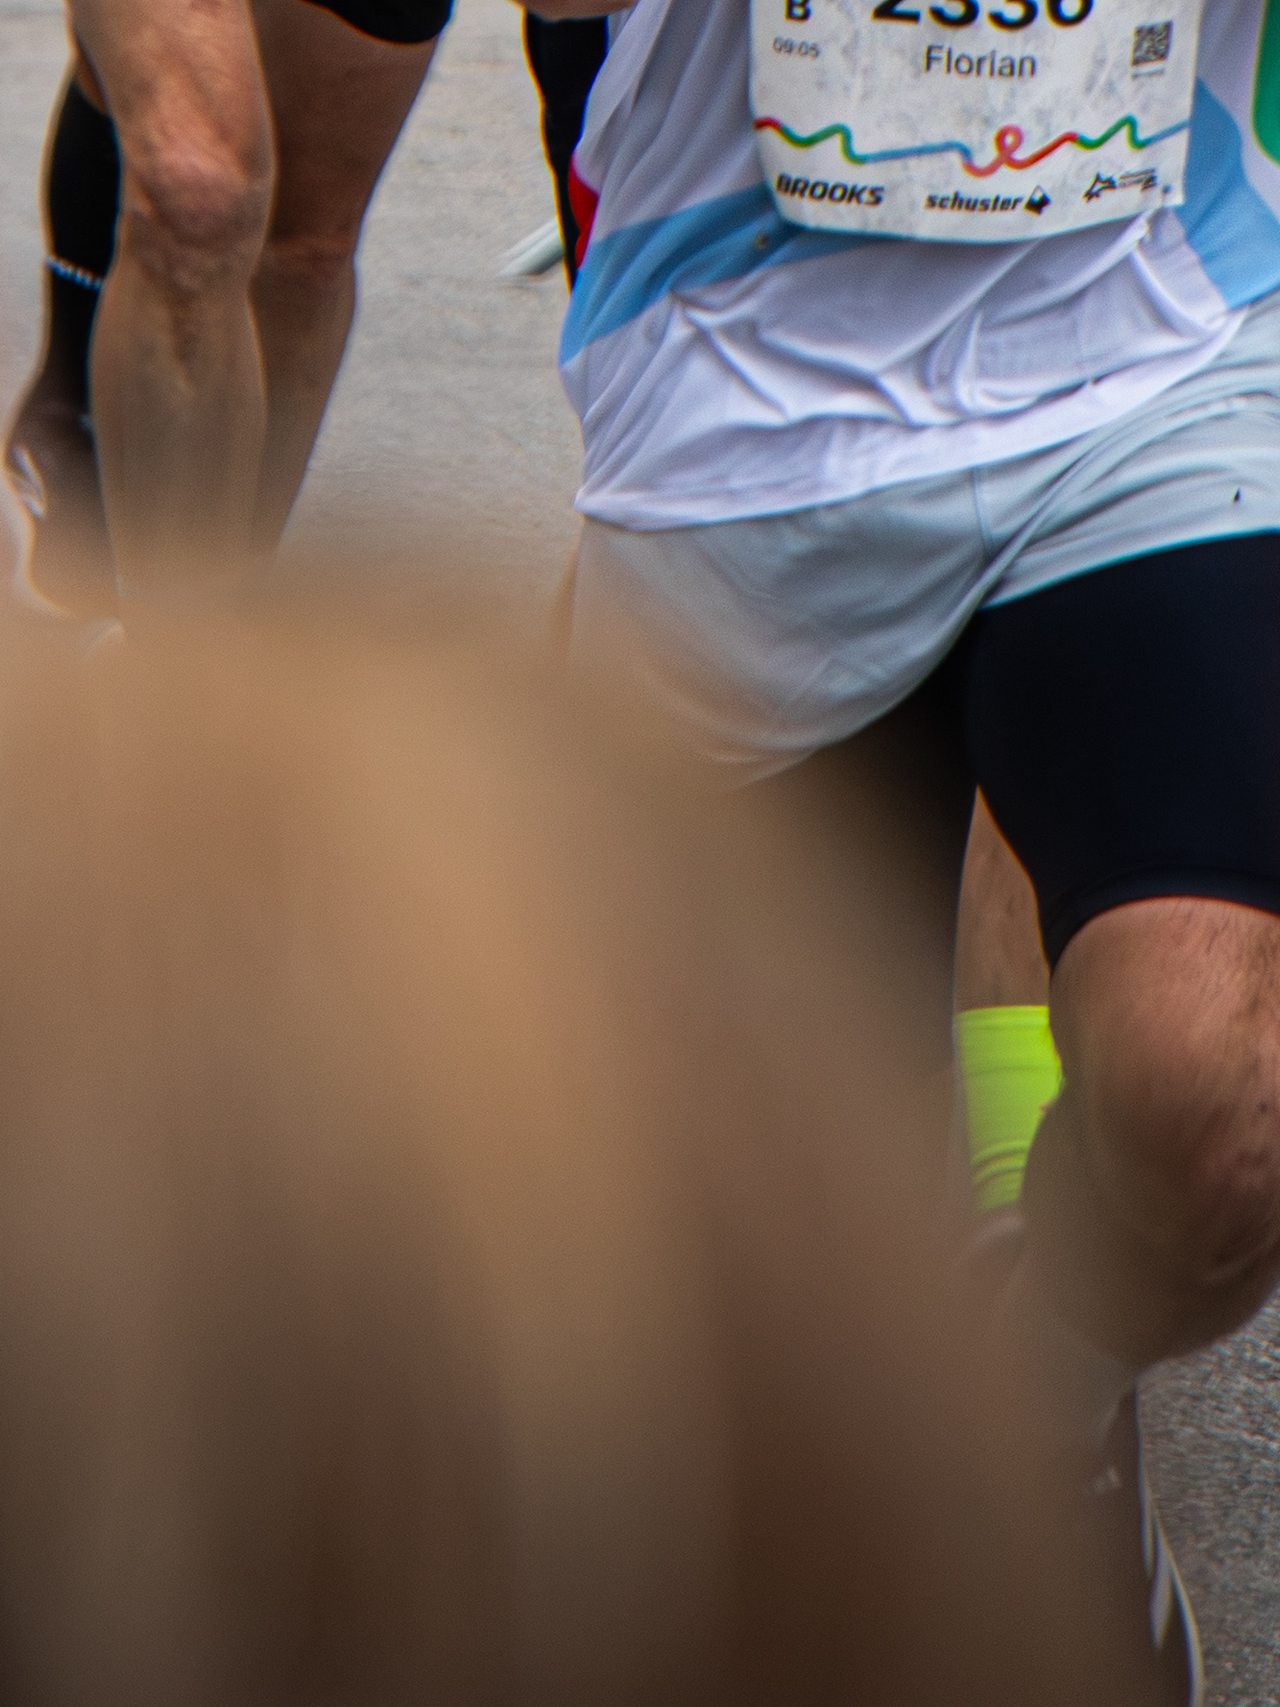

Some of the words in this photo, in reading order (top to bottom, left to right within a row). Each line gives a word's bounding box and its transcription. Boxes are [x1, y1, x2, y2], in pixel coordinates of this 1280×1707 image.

[923, 43, 1037, 79] Florian
[775, 171, 885, 207] BROOKS
[923, 190, 1023, 213] schuster
